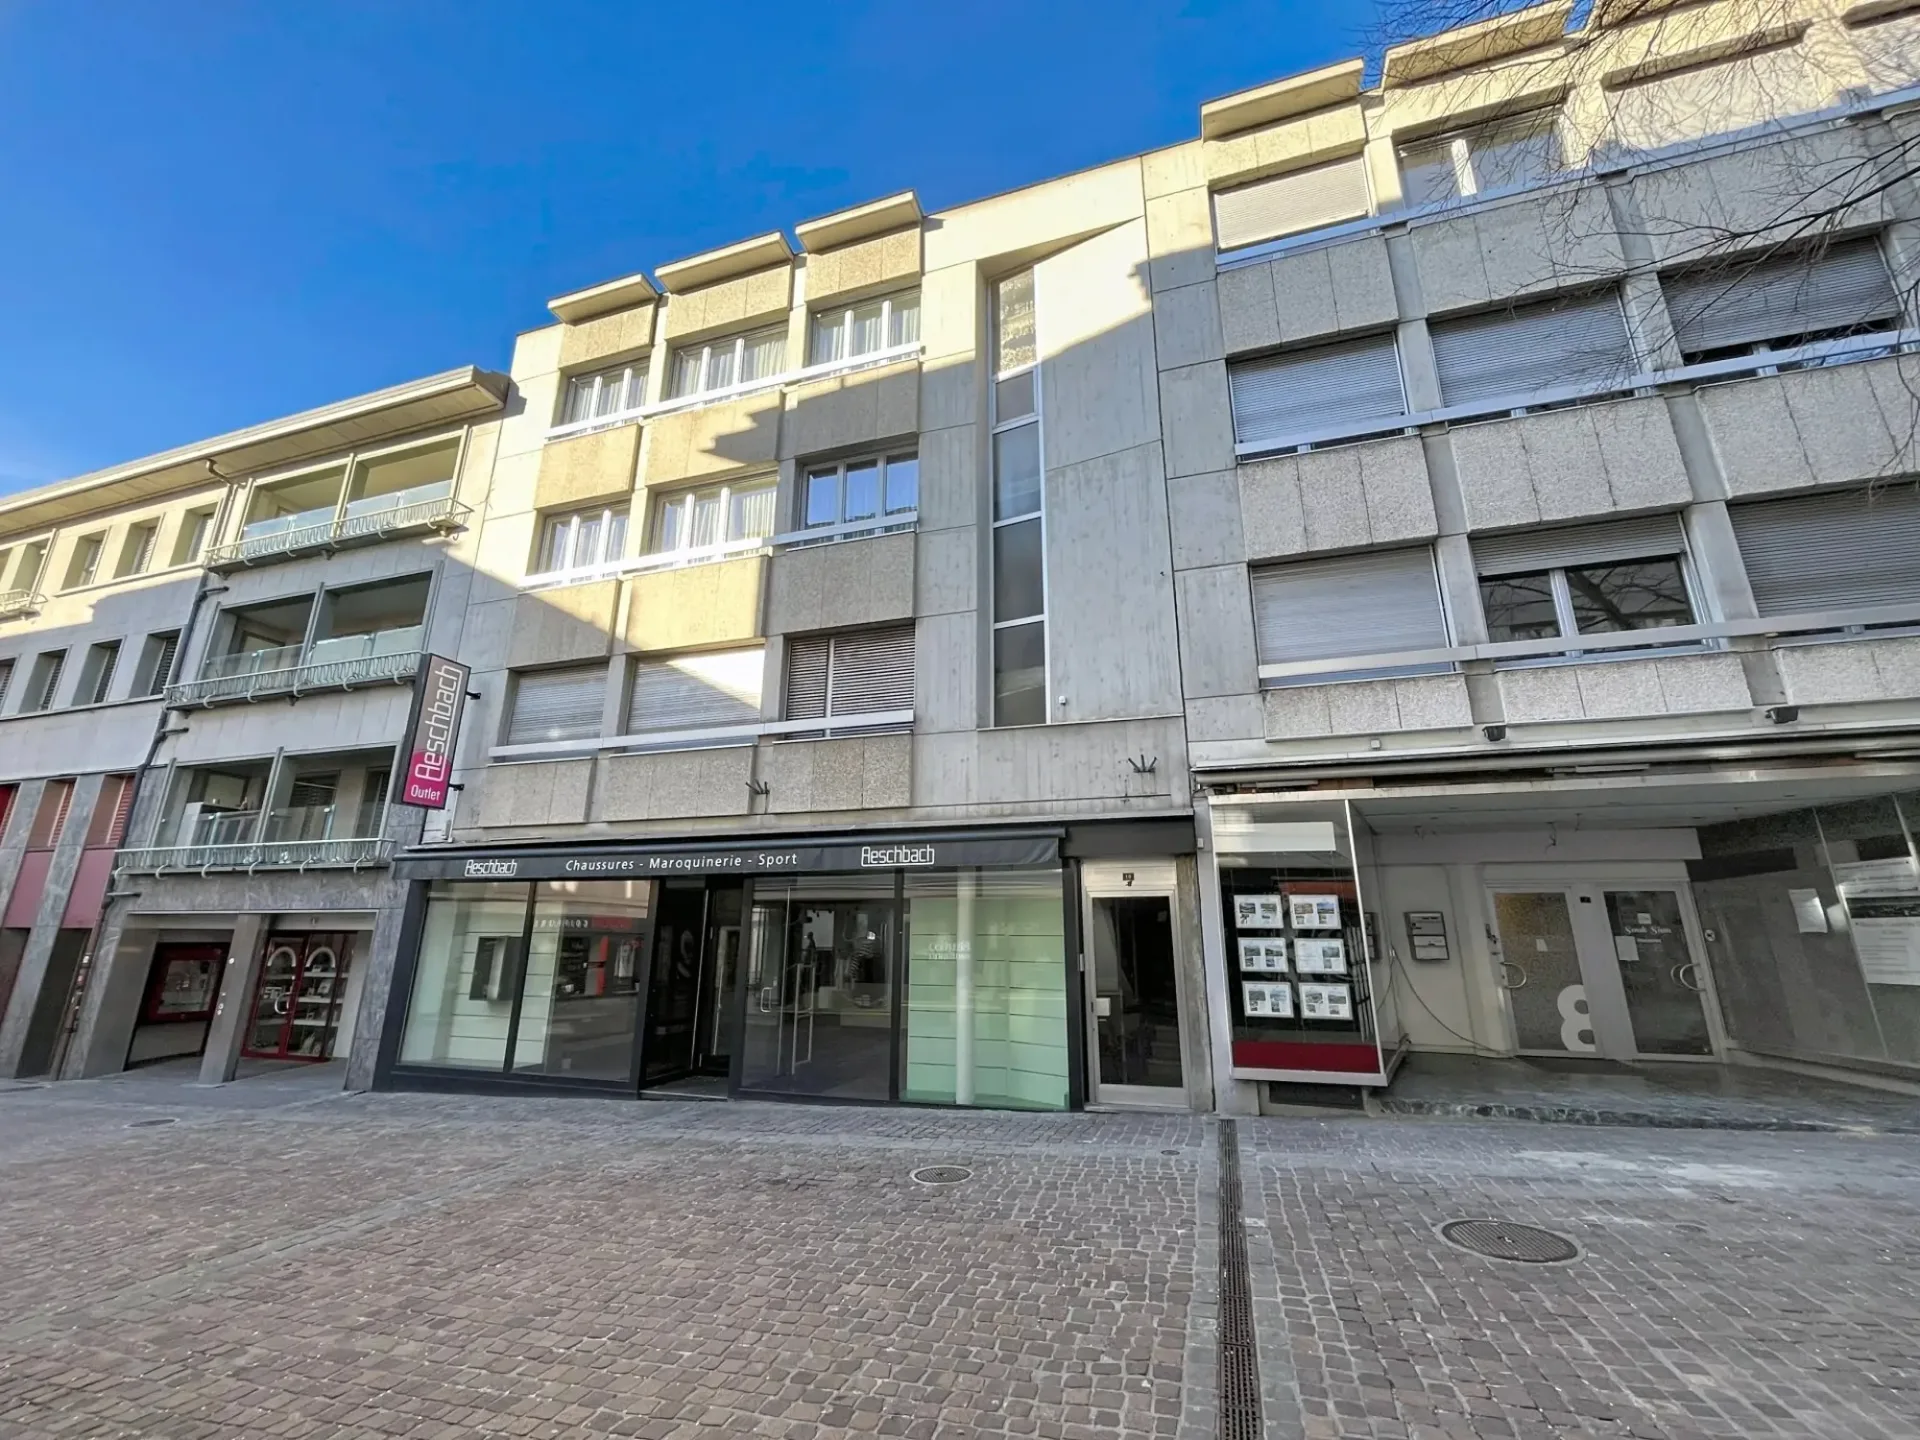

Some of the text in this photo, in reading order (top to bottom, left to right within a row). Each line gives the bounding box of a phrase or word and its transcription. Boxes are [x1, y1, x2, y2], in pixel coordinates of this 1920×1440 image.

[414, 664, 463, 782] Aeschbach
[410, 784, 441, 801] Outlet
[565, 859, 634, 871] Chaussures
[649, 855, 742, 870] Maroquinerie
[758, 853, 798, 868] Sport
[861, 845, 935, 867] Aeschbach
[464, 859, 518, 877] Aeschbach
